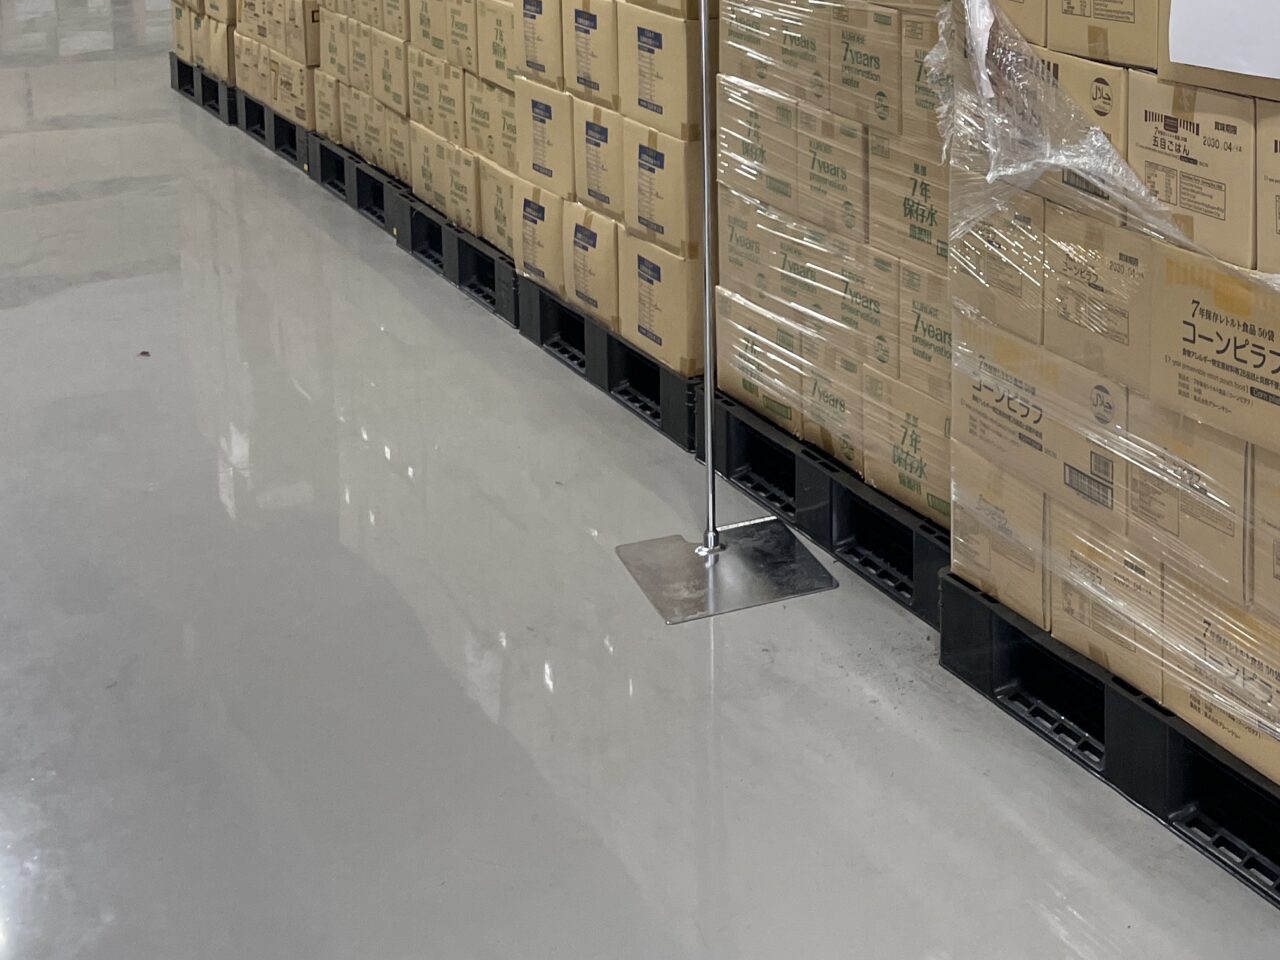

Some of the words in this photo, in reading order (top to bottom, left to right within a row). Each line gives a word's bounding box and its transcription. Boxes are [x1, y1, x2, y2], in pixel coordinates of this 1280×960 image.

[841, 41, 881, 71] 7years
[1152, 135, 1190, 157] 五目ごはん
[809, 150, 847, 180] 7years
[909, 178, 931, 204] 7年
[903, 197, 938, 227] 保存水
[841, 279, 881, 314] 7years
